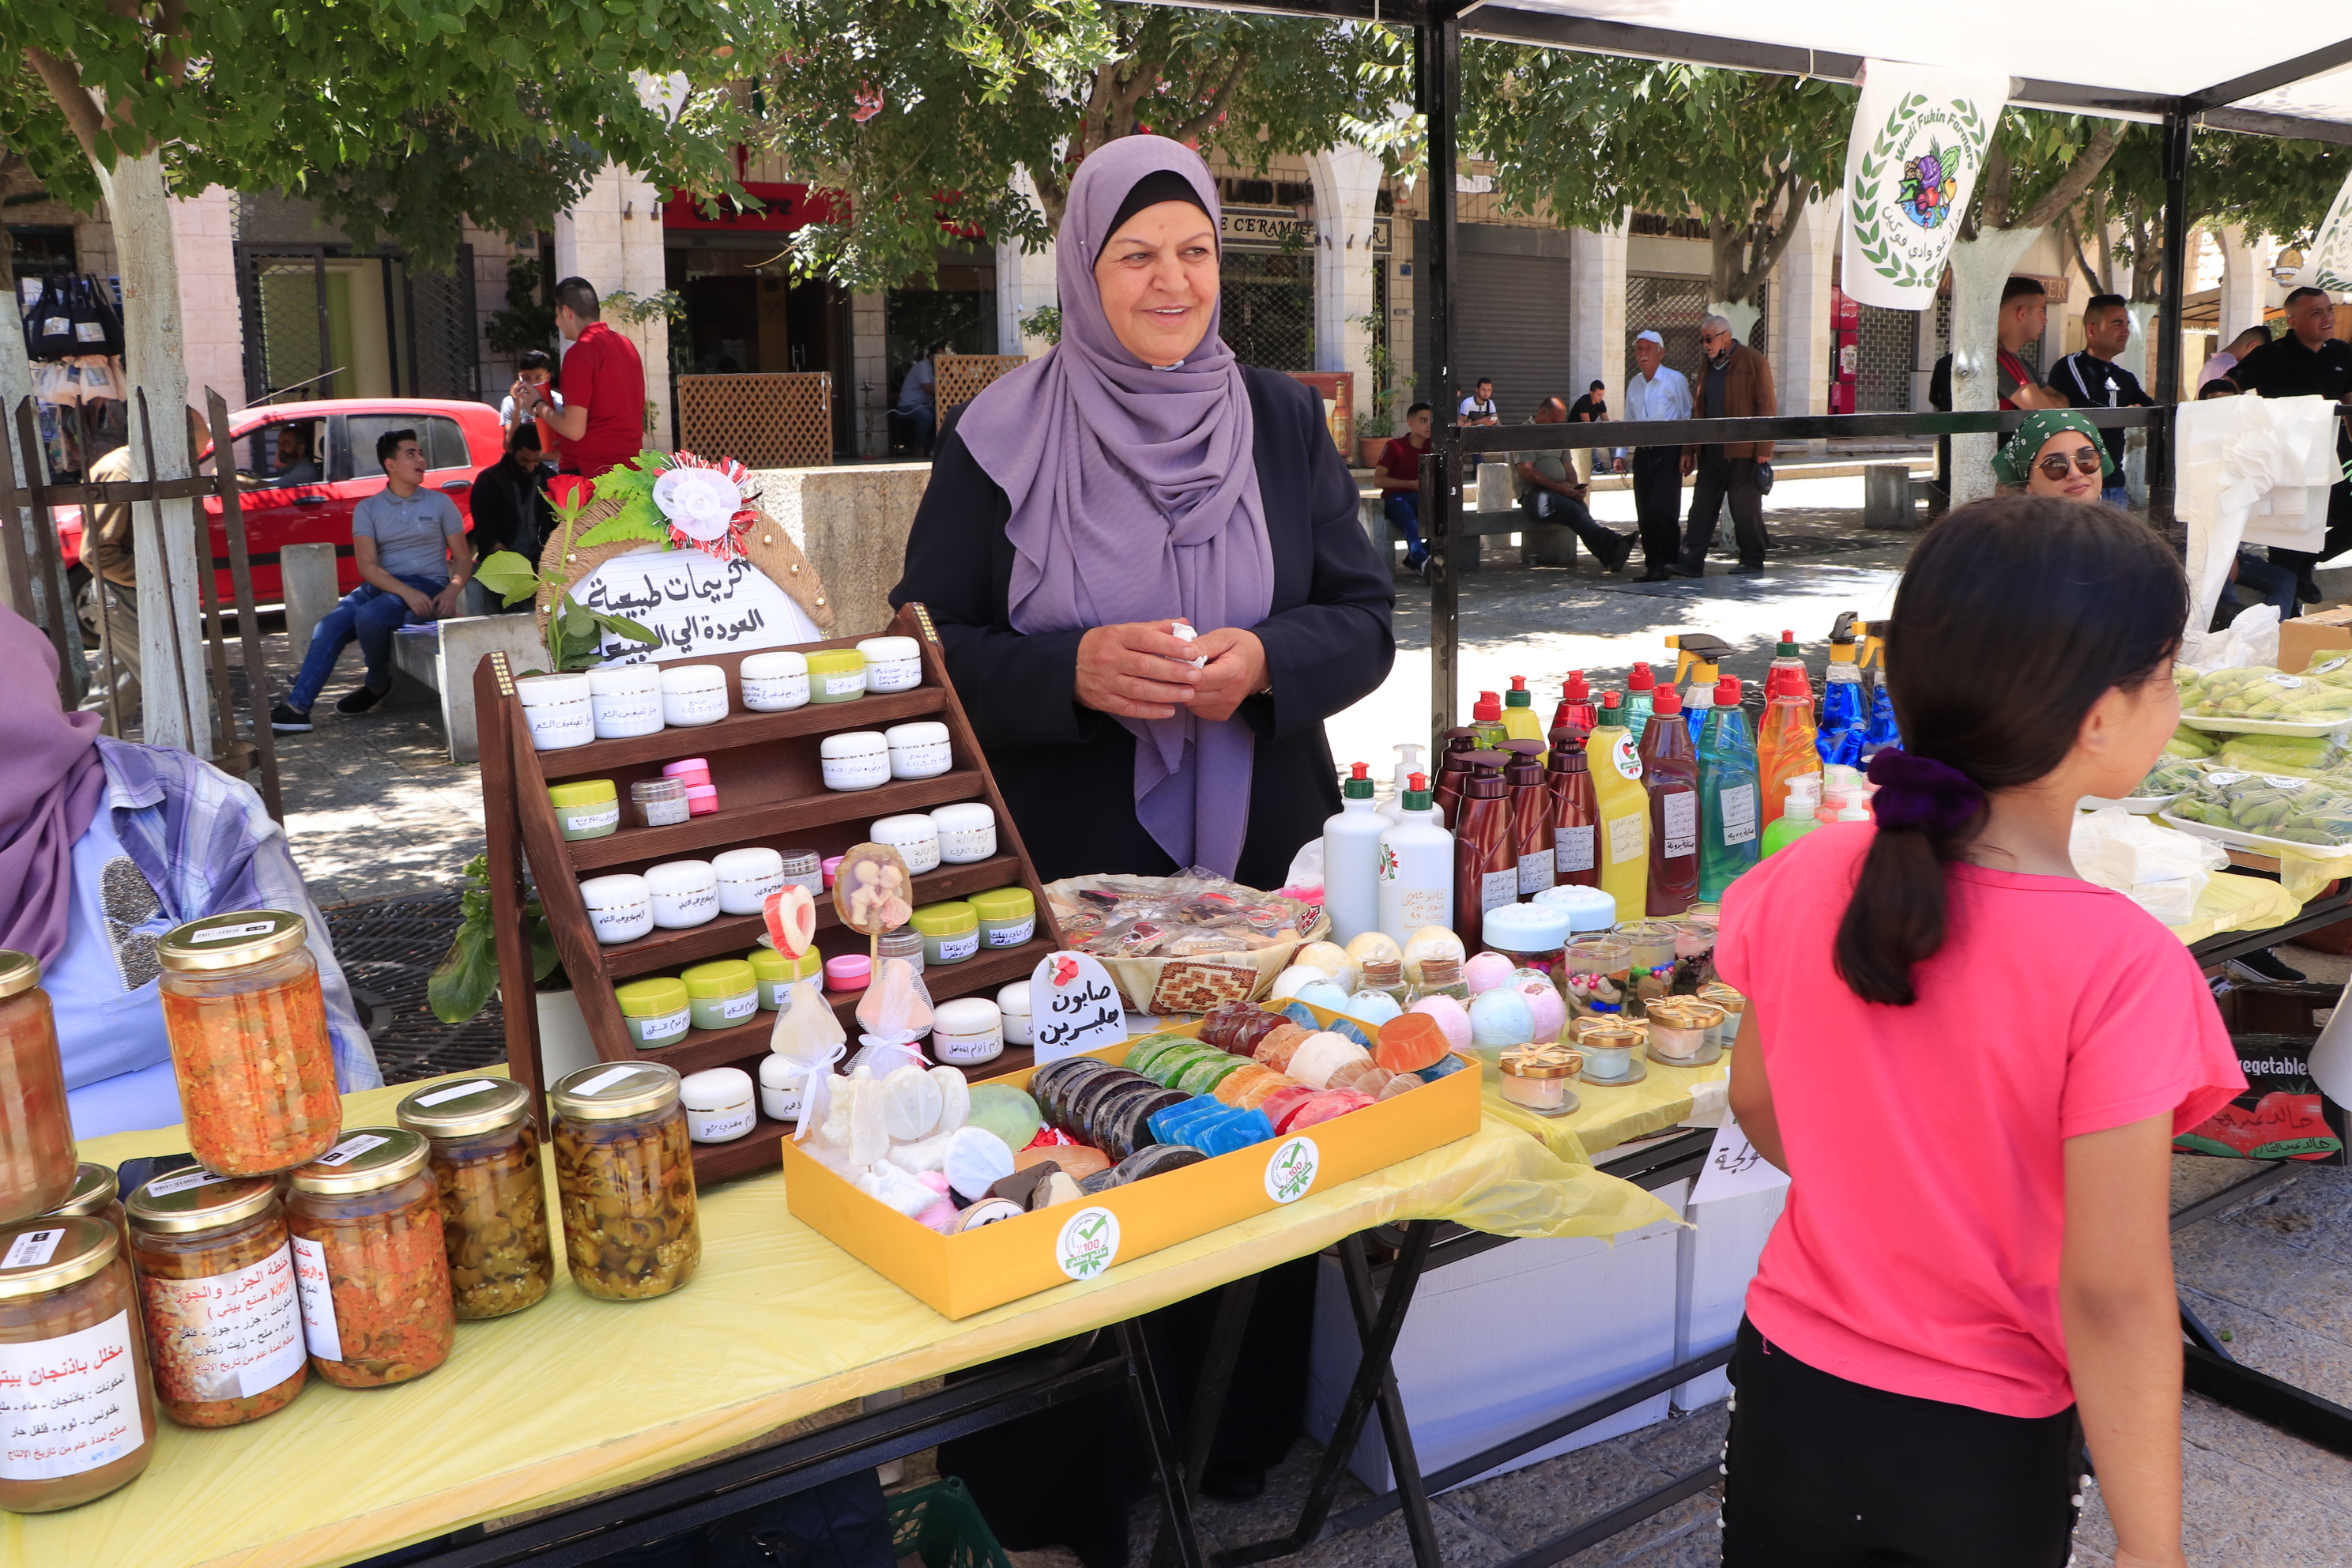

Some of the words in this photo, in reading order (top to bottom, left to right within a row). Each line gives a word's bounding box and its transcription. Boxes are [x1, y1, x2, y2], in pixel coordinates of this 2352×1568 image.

[1895, 122, 1917, 162] Wadi
[1917, 107, 1946, 130] Fukin
[1947, 112, 1973, 171] Farmers
[1883, 206, 1909, 247] فوكين
[1908, 242, 1932, 261] وادي
[665, 558, 751, 604] كريمات
[588, 574, 662, 619] طبيعية
[701, 608, 764, 642] العودة
[603, 623, 670, 665] البيع
[1052, 980, 1111, 1015] صابون
[646, 1020, 669, 1037] السكري
[1069, 1254, 1090, 1269] وطني
[1091, 1249, 1107, 1261] منتج
[267, 1255, 288, 1276] خلطة
[228, 1270, 264, 1296] الجزر
[217, 1302, 241, 1318] بيتي
[245, 1292, 267, 1311] صنع
[243, 1315, 261, 1330] جزر
[281, 1316, 291, 1334] ثوم
[211, 1325, 230, 1338] جوز
[258, 1328, 273, 1344] ملح
[194, 1344, 224, 1357] زيتون
[227, 1337, 247, 1351] زيت
[93, 1344, 123, 1370] مخلل
[220, 1358, 240, 1373] تاريخ
[243, 1355, 254, 1366] من
[256, 1351, 267, 1363] عام
[0, 1370, 22, 1388] بيت
[29, 1356, 89, 1386] باذنجان
[96, 1374, 126, 1395] المكونات
[22, 1402, 38, 1412] ماء
[51, 1391, 85, 1410] باذنجان
[89, 1404, 120, 1425] بقدونس
[11, 1427, 27, 1438] حار
[29, 1423, 49, 1437] فلفل
[61, 1417, 77, 1432] ثوم
[108, 1424, 126, 1442] صالح
[74, 1441, 88, 1454] عام
[91, 1433, 107, 1446] لمدة
[34, 1448, 56, 1460] تاريخ
[58, 1446, 72, 1457] من
